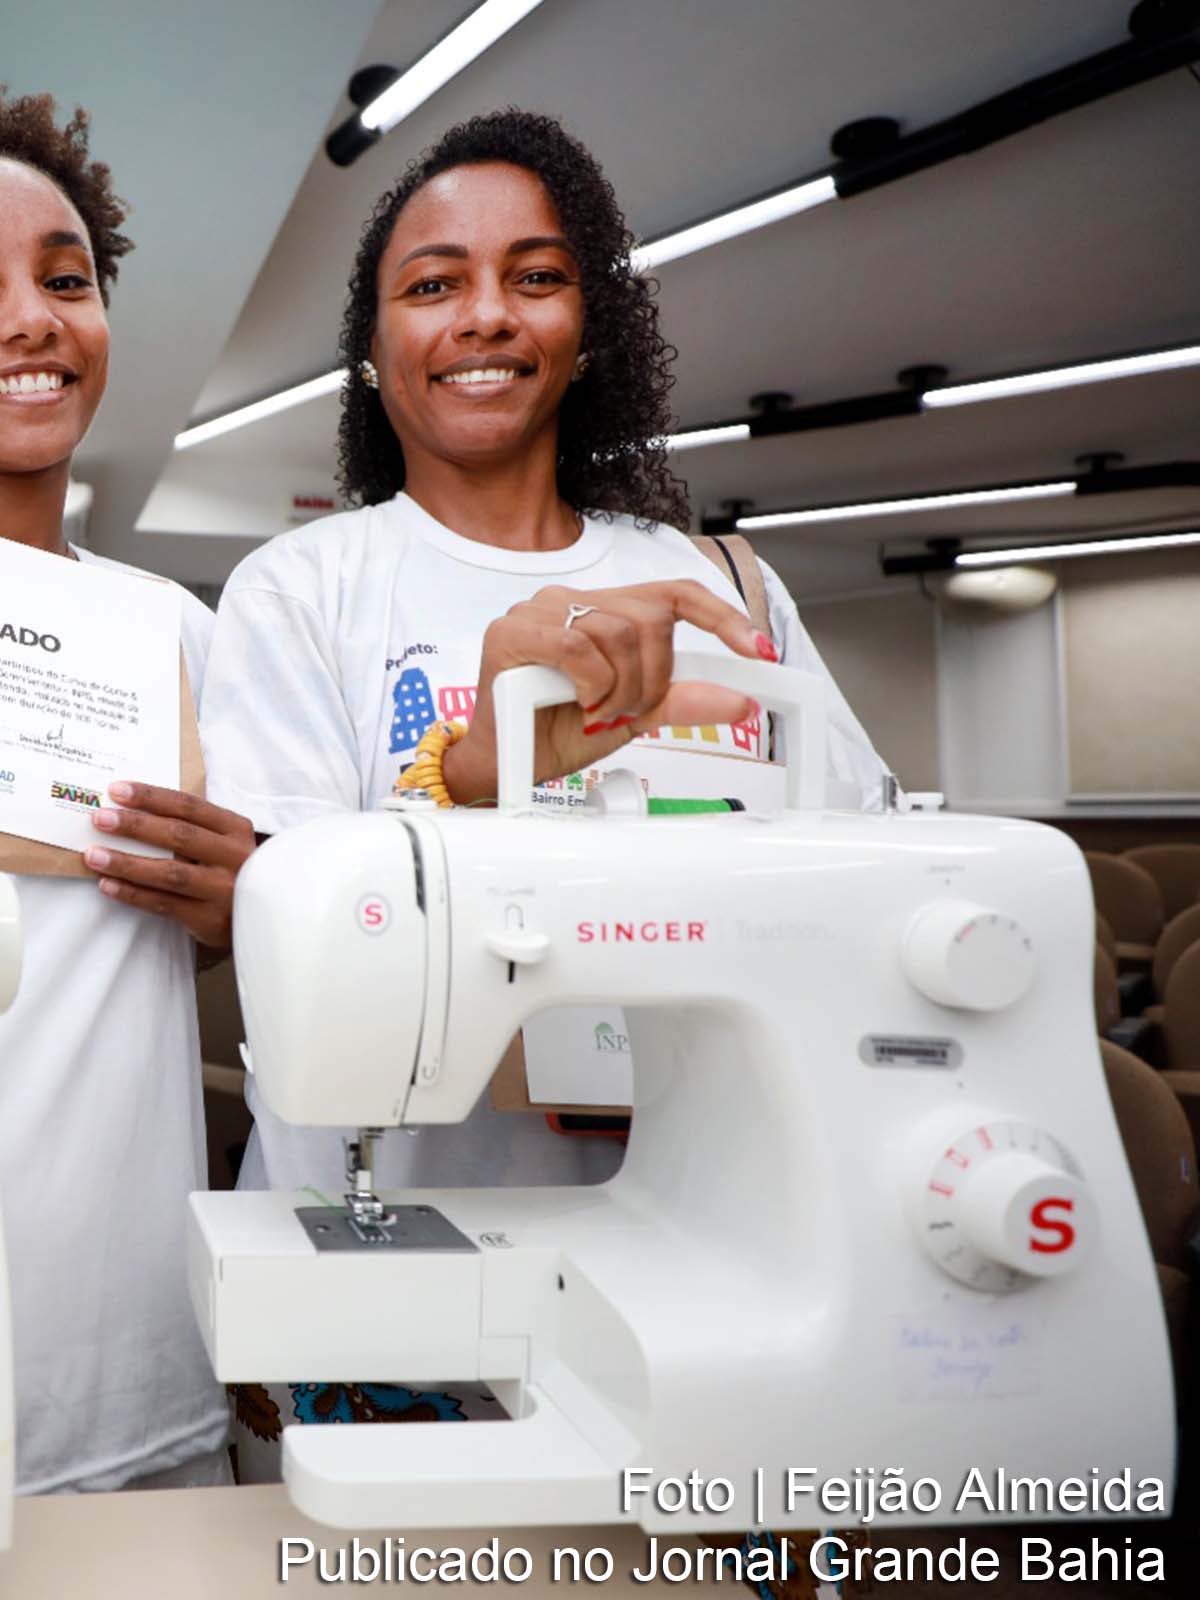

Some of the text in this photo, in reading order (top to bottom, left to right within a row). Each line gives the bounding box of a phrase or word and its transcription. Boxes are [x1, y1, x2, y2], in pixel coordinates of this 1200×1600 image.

[364, 903, 384, 926] S
[576, 921, 706, 943] SINGER
[1029, 1197, 1076, 1255] S
